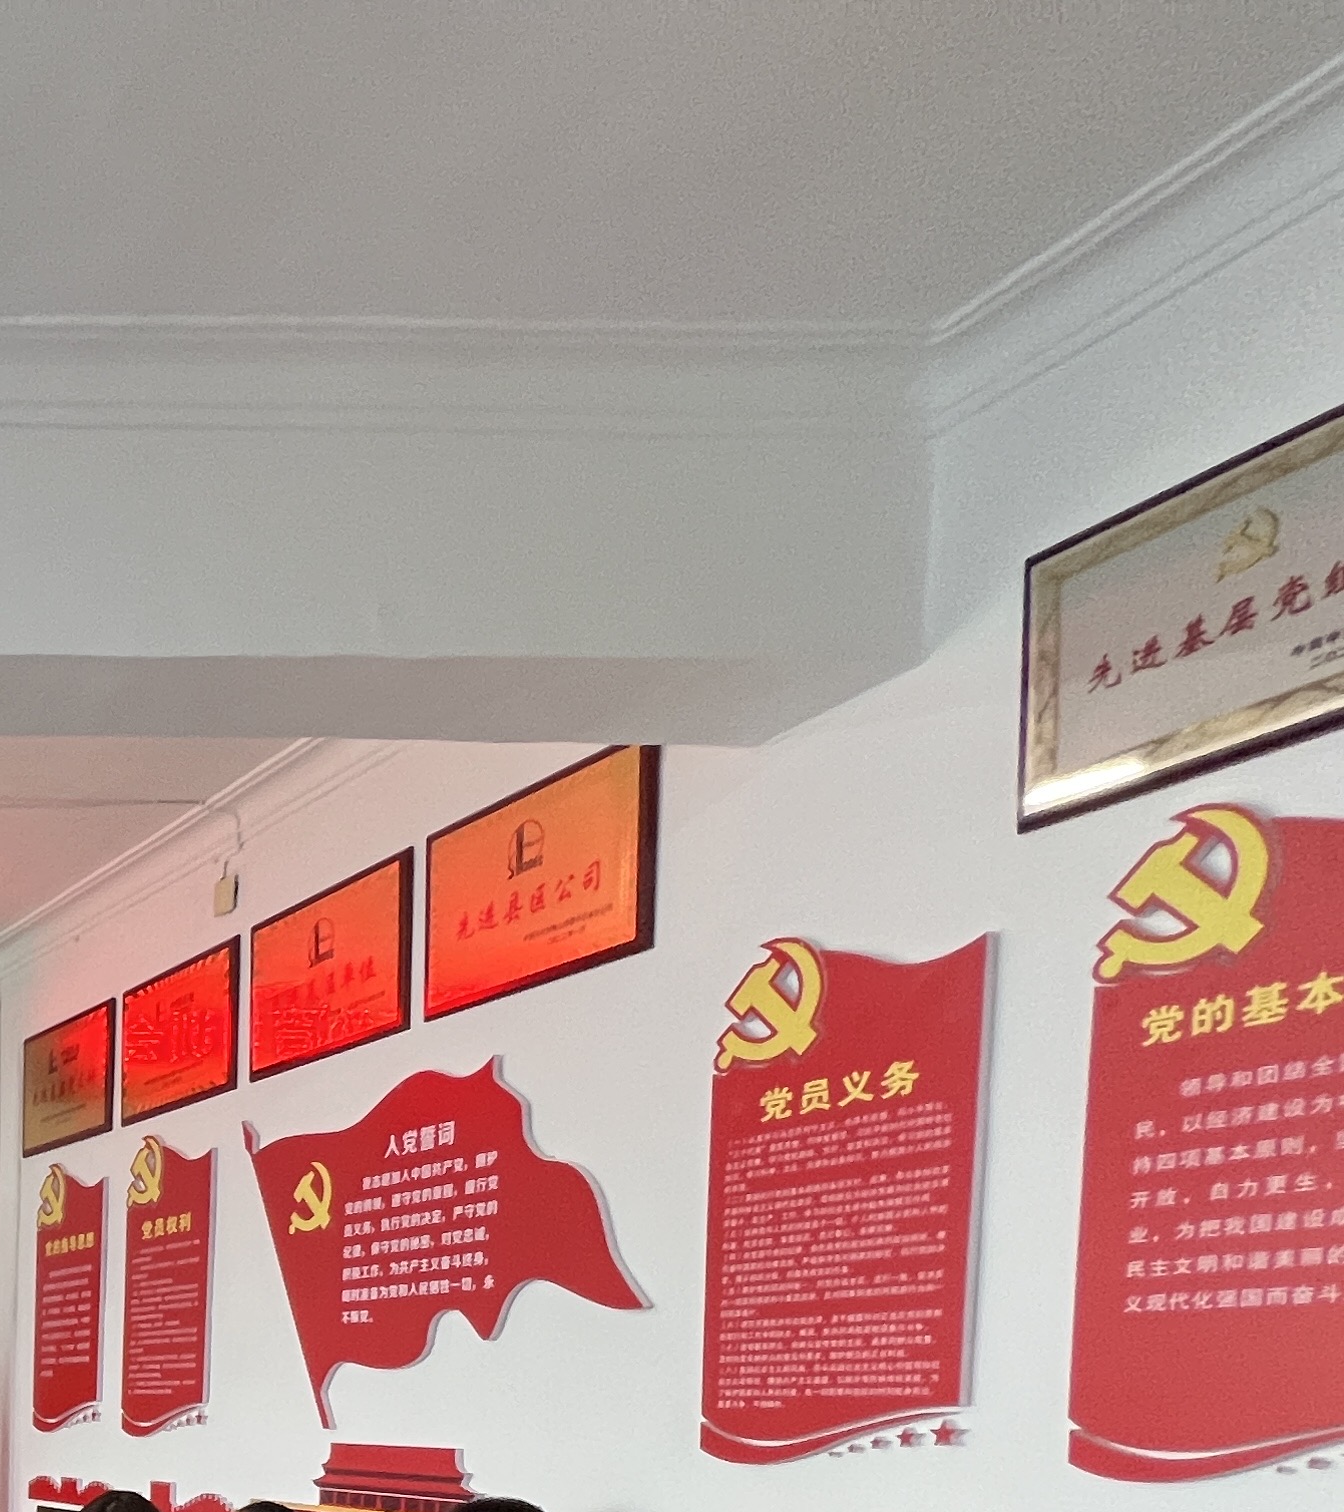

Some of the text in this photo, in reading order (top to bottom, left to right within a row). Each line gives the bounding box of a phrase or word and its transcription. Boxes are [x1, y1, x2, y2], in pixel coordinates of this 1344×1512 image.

[1141, 971, 1344, 1047] 党的基本
[759, 1060, 920, 1122] 党员义务
[1179, 1053, 1344, 1098] 领导和团结全
[1133, 1094, 1344, 1140] 民，以经济建设为
